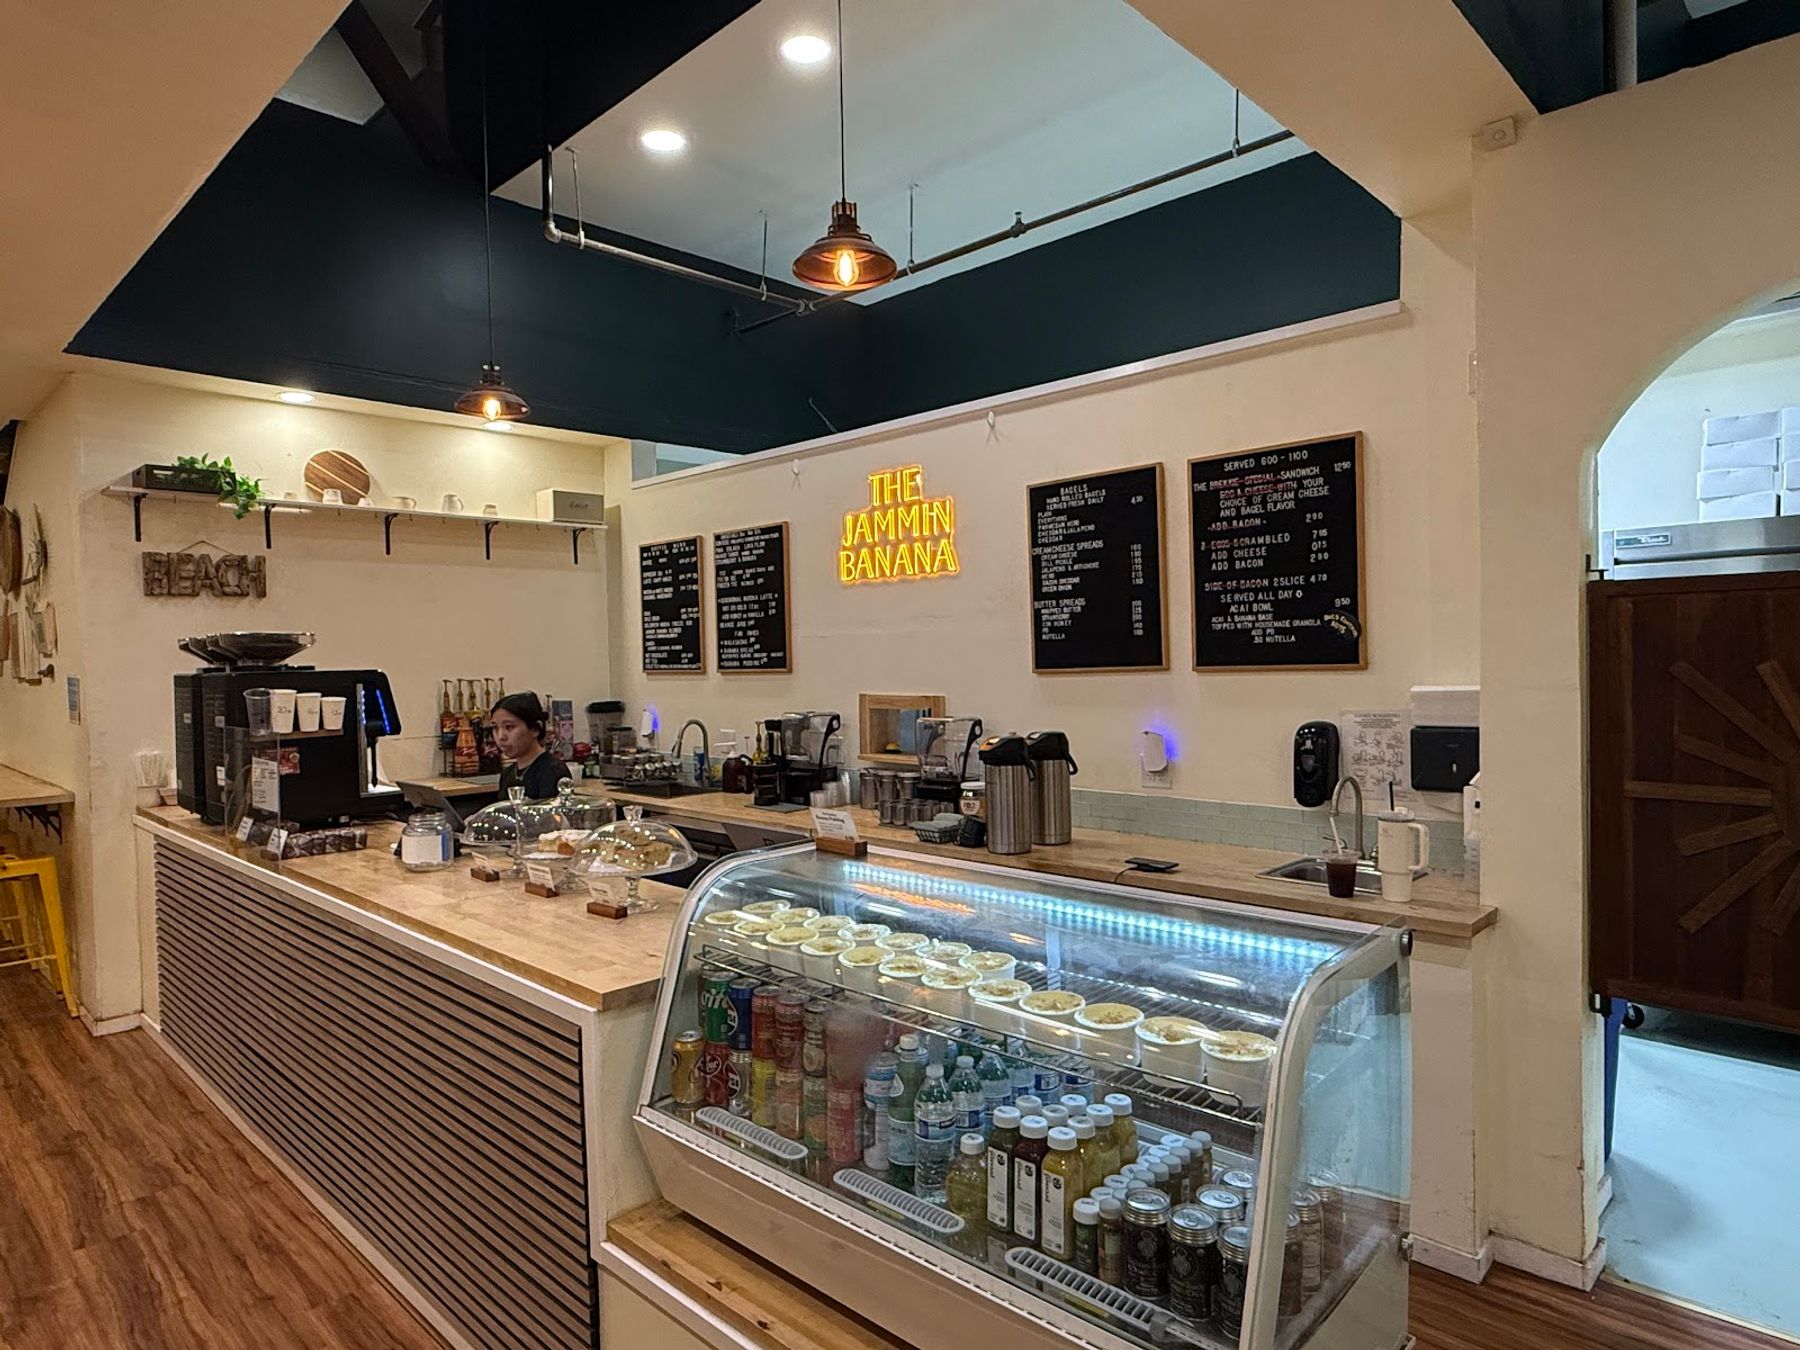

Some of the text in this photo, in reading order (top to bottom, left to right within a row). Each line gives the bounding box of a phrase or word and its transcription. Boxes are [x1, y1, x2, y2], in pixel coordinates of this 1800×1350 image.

[1224, 458, 1255, 471] SERVED
[1334, 461, 1351, 472] 1250
[1193, 482, 1207, 491] THE
[1245, 473, 1276, 485] SPECIAL
[1281, 466, 1320, 479] SANDWICH
[868, 468, 921, 506] THE
[1060, 484, 1088, 495] BAGELS
[1245, 484, 1273, 496] CHEESE
[1278, 481, 1297, 490] WITH
[1302, 477, 1324, 487] YOUR
[1085, 489, 1106, 498] BAGELS
[1220, 486, 1329, 508] CHOICE OF CREAM CHEESE
[1220, 500, 1295, 518] AND BAGEL FLAVOR
[843, 499, 951, 546] JAMMIN
[1211, 518, 1261, 531] ADD BACON
[1052, 543, 1075, 553] CHEESE
[1077, 540, 1103, 550] SPREADS
[1211, 539, 1230, 549] EGGS
[1233, 533, 1290, 547] SCRAMBLED
[840, 539, 956, 580] BANANA
[1211, 547, 1267, 560] ADD CHEESE
[1211, 559, 1263, 571] ADD BACON
[142, 552, 266, 598] BEACH
[1227, 581, 1237, 589] OF
[1240, 579, 1268, 589] BACON
[1059, 598, 1086, 607] SPREADS
[1220, 591, 1292, 603] SERVED ALL DAY
[1230, 603, 1274, 613] ACAI BOWL
